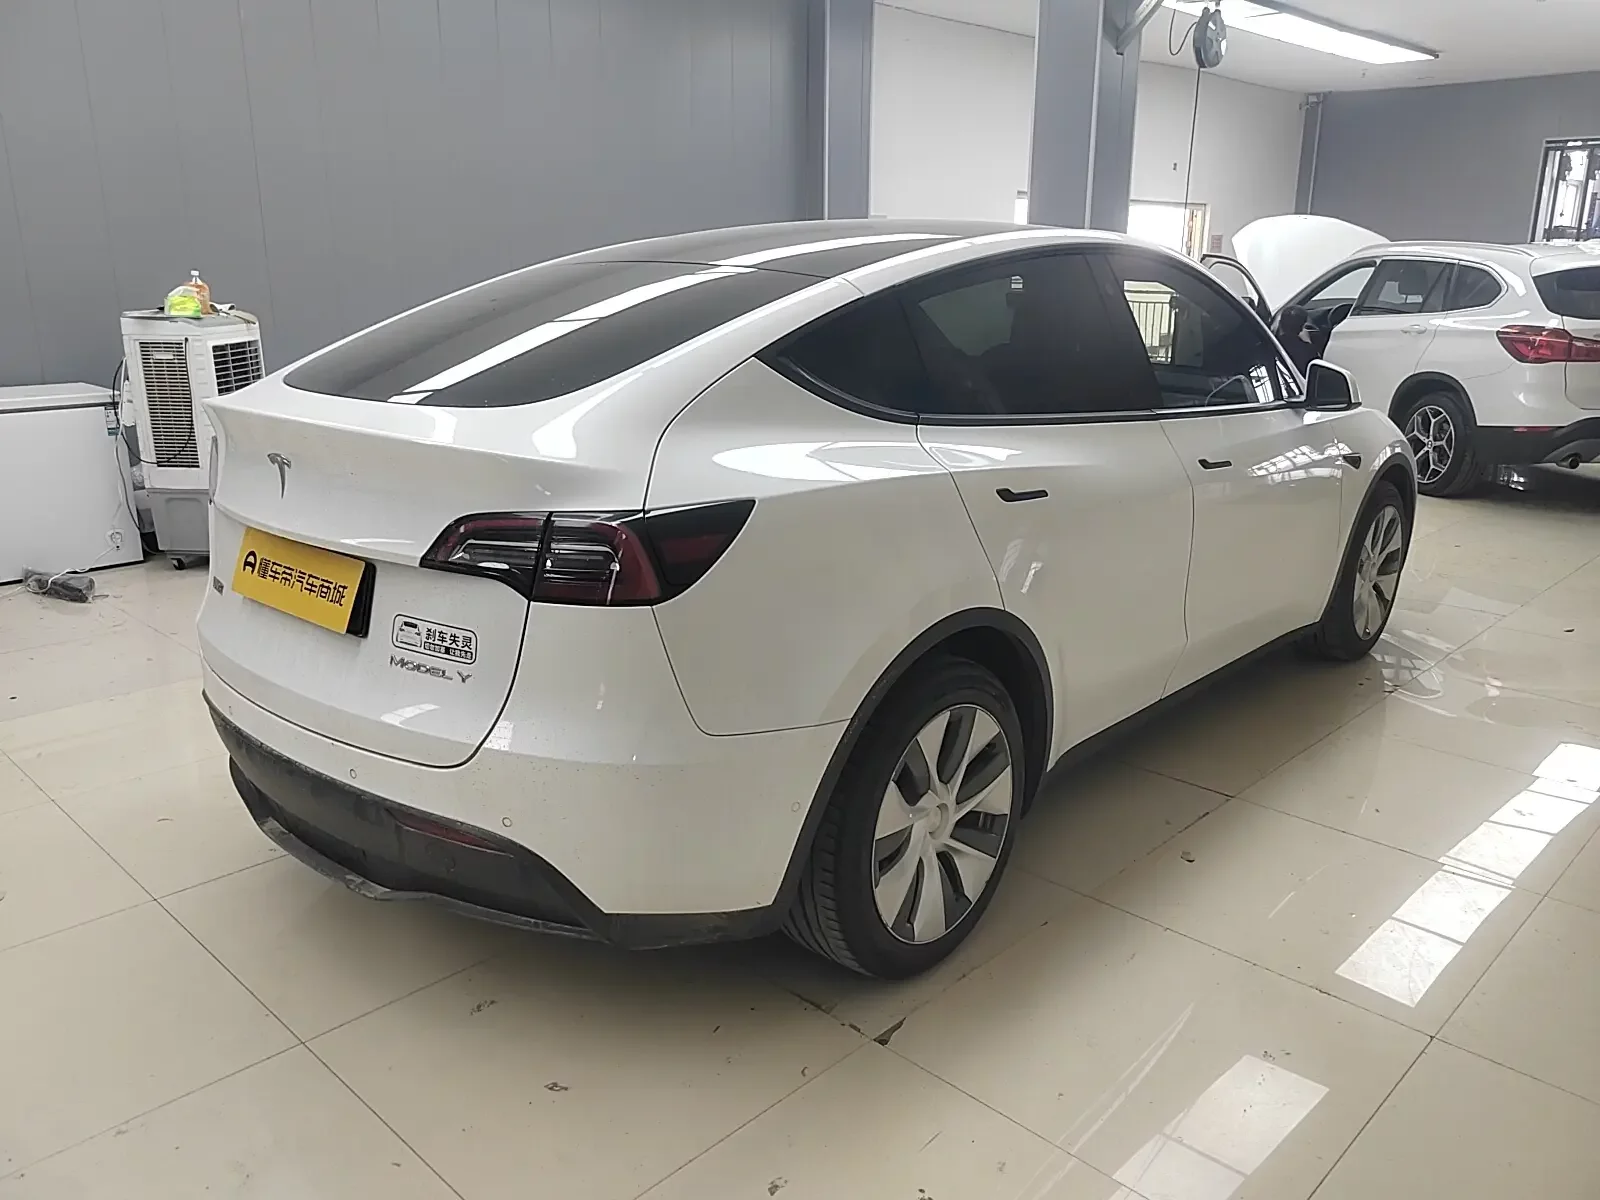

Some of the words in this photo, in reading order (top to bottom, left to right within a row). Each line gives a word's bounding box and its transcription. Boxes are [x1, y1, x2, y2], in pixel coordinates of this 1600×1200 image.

[257, 557, 348, 606] 懂车帝汽车商城
[425, 627, 472, 650] 刹车失灵
[390, 655, 453, 680] MODEL
[456, 670, 472, 683] Y
